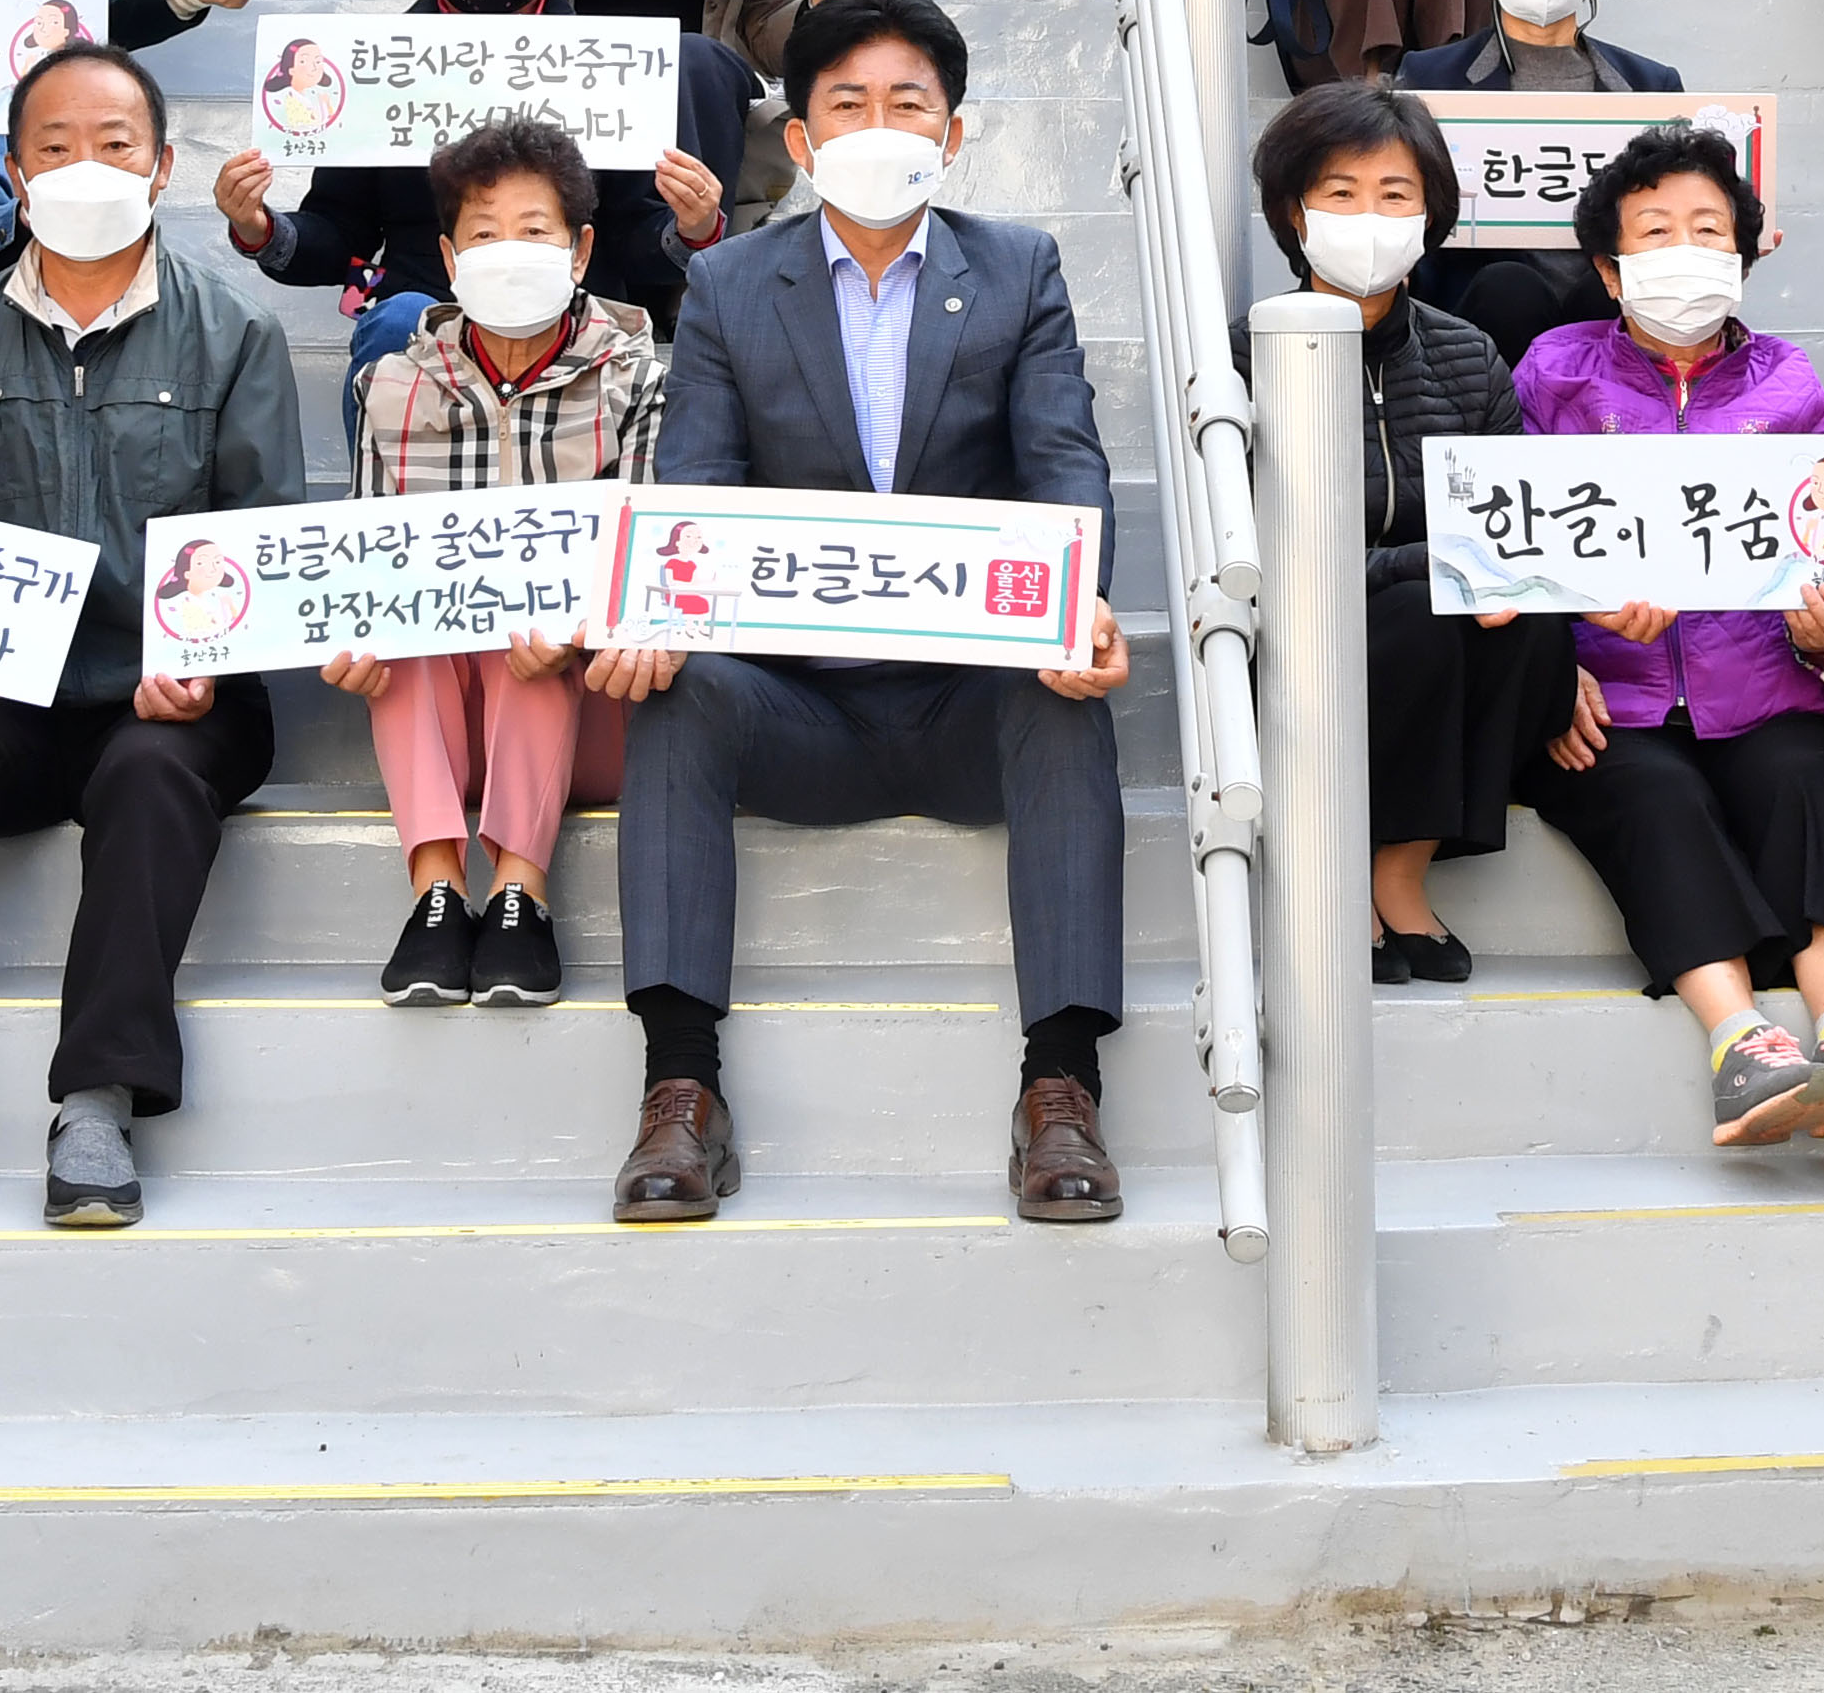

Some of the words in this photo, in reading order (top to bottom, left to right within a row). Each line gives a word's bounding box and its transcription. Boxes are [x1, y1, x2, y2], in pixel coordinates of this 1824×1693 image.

[351, 34, 494, 87] 한글사랑
[504, 36, 673, 89] 울산중구가
[256, 522, 420, 581] 한글사랑
[1467, 479, 1646, 560] 한글이
[1680, 482, 1779, 576] 목숨
[750, 545, 966, 605] 한글도시
[992, 588, 1042, 614] 중구
[993, 561, 1043, 589] 울산
[298, 575, 581, 644] 앞장서겠습니다
